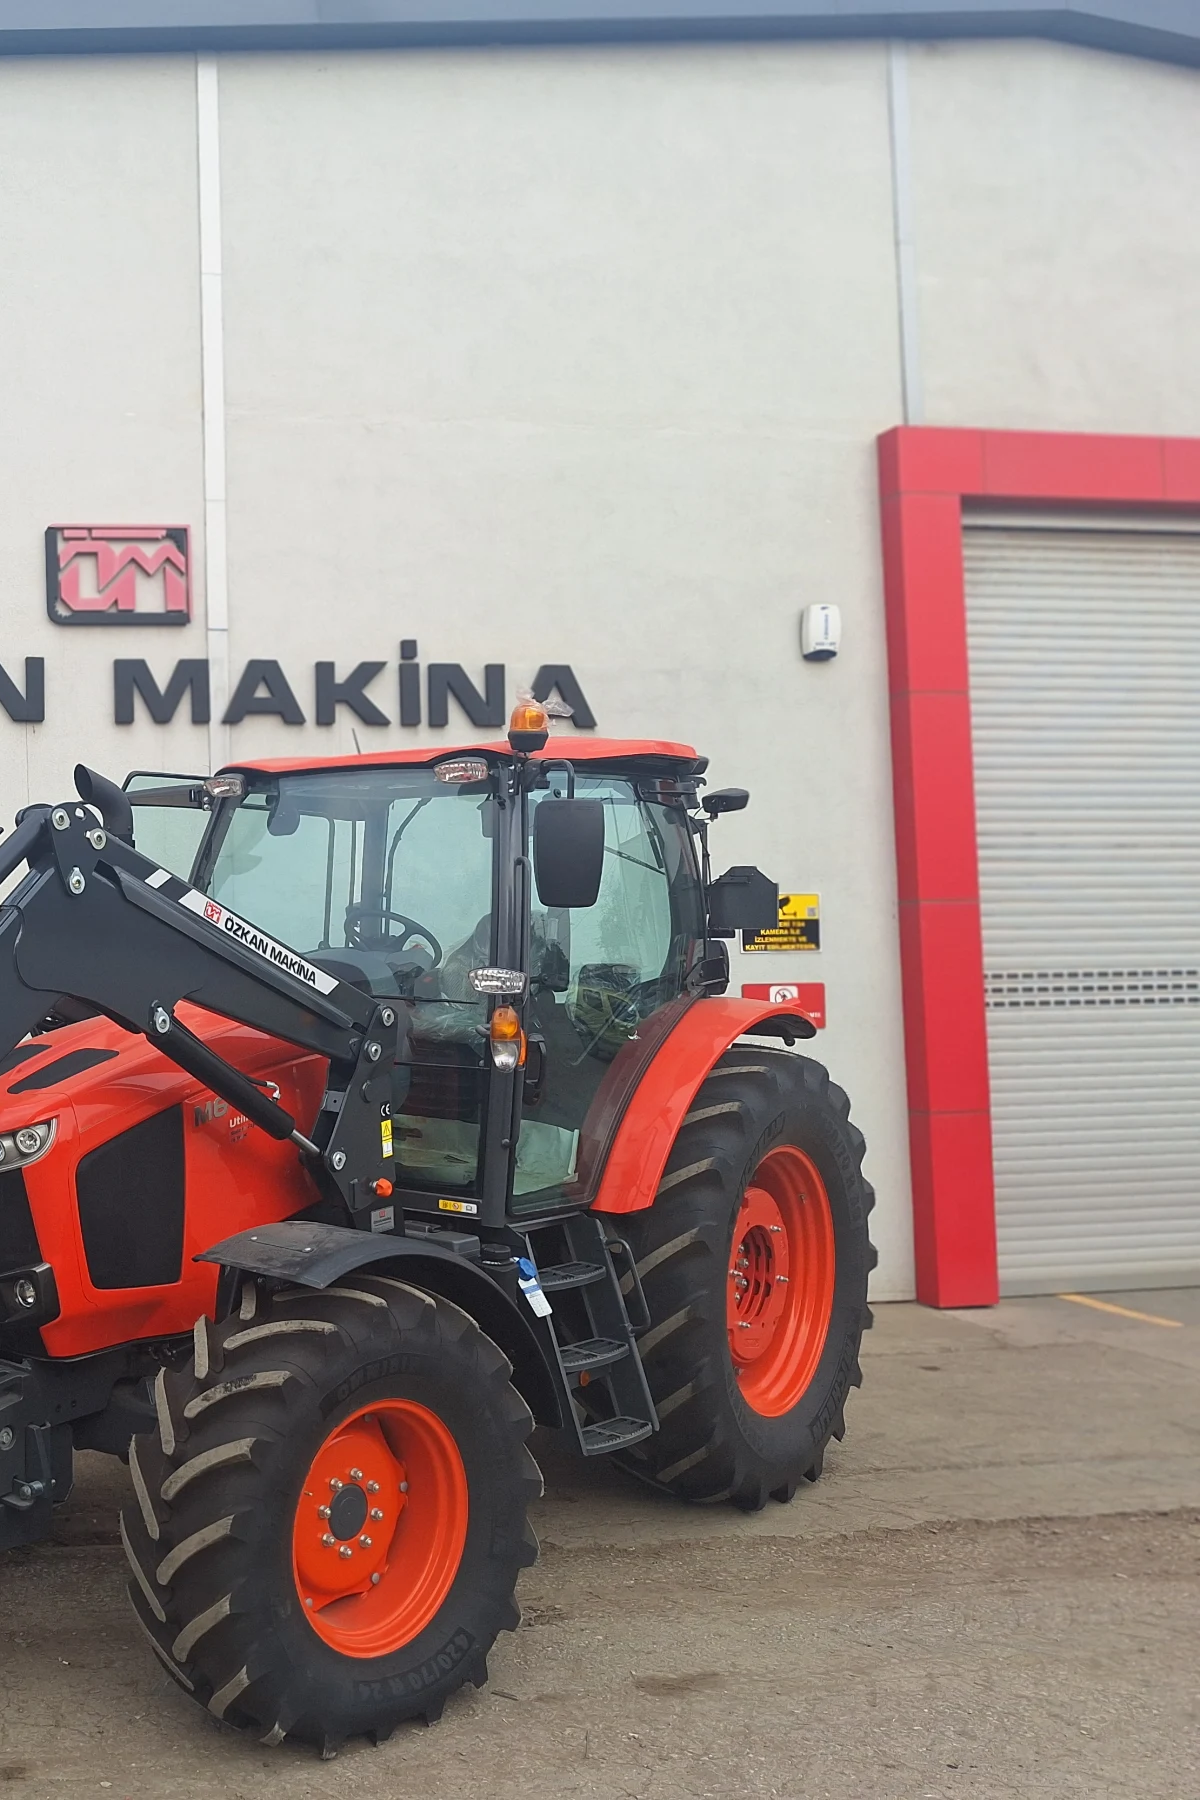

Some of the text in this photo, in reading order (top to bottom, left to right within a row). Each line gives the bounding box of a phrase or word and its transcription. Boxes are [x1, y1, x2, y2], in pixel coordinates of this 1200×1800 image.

[113, 639, 598, 729] MAKİNA
[224, 915, 317, 986] ÖZKAN MAKİNA
[229, 1114, 249, 1128] Util
[381, 1103, 390, 1117] CE
